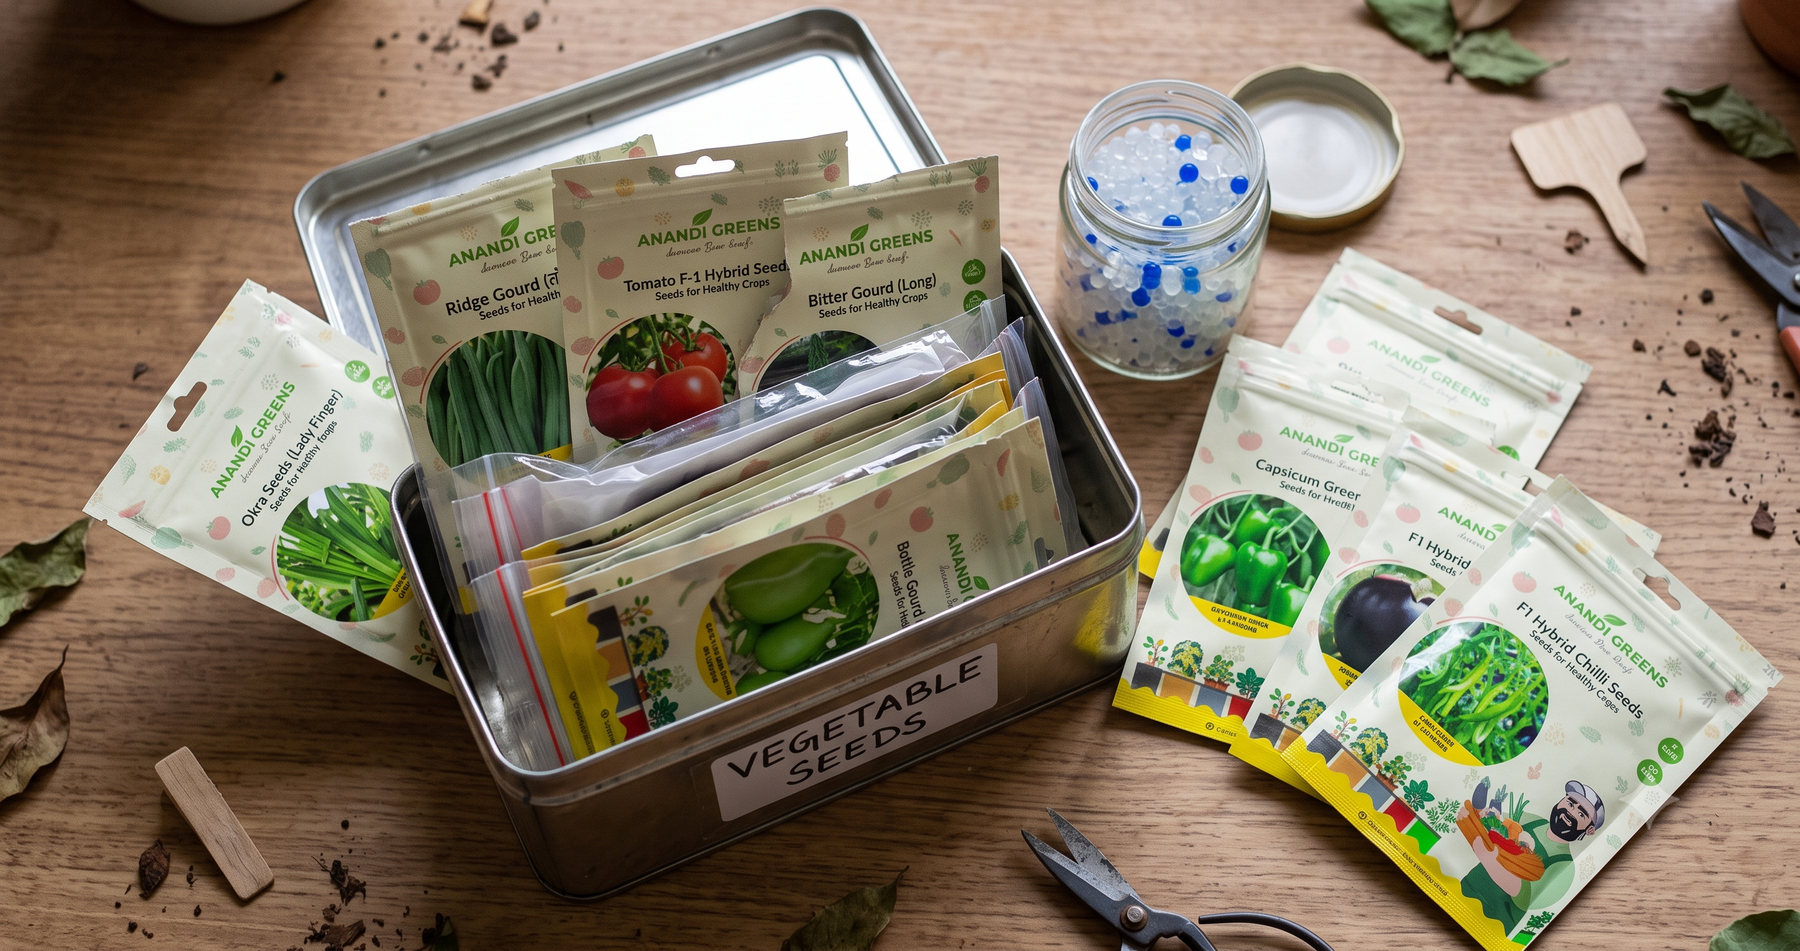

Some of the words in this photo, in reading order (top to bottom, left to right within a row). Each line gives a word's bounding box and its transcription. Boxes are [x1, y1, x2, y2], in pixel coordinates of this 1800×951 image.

[449, 236, 520, 268] ANANDI
[524, 224, 556, 245] GRE
[637, 226, 707, 247] ANANDI
[712, 216, 781, 237] GREENS
[799, 241, 865, 266] ANANDI
[869, 229, 934, 253] GREENS
[445, 294, 490, 316] Ridge
[492, 277, 540, 301] Gourd
[623, 275, 676, 293] Tomato
[679, 271, 701, 285] F-1
[705, 263, 750, 283] Hybrid
[655, 289, 684, 301] Seeds
[686, 286, 701, 296] for
[703, 281, 740, 295] Healthy
[742, 278, 770, 290] Crops
[808, 289, 848, 308] Bitter
[851, 280, 894, 300] Gourd
[897, 272, 937, 294] (Long)
[479, 305, 510, 321] Seeds
[511, 300, 526, 312] for
[527, 290, 561, 307] Health
[818, 305, 847, 319] Seeds
[849, 302, 863, 314] for
[864, 296, 900, 312] Healthy
[902, 292, 928, 305] Crops
[1367, 339, 1429, 374] ANANDI
[1431, 370, 1491, 408] GREENS
[210, 439, 256, 499] ANANDI
[251, 381, 296, 439] GREENS
[241, 496, 268, 528] Okra
[262, 459, 293, 496] Seeds
[286, 427, 315, 463] (Lady
[308, 388, 345, 430] Finger)
[1279, 426, 1345, 456] ANANDI
[1348, 449, 1380, 468] GRE
[1255, 458, 1320, 488] Capsicum
[1279, 480, 1306, 496] Seeds
[1307, 489, 1322, 501] for
[269, 486, 292, 513] Seeds
[286, 473, 300, 488] for
[1437, 506, 1497, 542] ANAND
[897, 540, 916, 579] Bottle
[946, 533, 974, 595] ANANDI
[1408, 531, 1425, 547] F1
[1425, 540, 1472, 570] Hybrid
[1429, 558, 1457, 577] Seeds
[889, 570, 903, 597] Seeds
[896, 597, 906, 609] for
[906, 579, 926, 618] Gourd
[1553, 584, 1612, 637] ANANDI
[1611, 634, 1669, 689] GREENS
[1516, 601, 1534, 618] F1
[1532, 614, 1577, 655] Hybrid
[1607, 682, 1644, 720] Seeds
[1529, 629, 1554, 654] Seeds
[1553, 650, 1567, 665] for
[1565, 661, 1597, 693] Healthy
[727, 655, 983, 778] VEGETABLE
[786, 711, 927, 786] SEEDS
